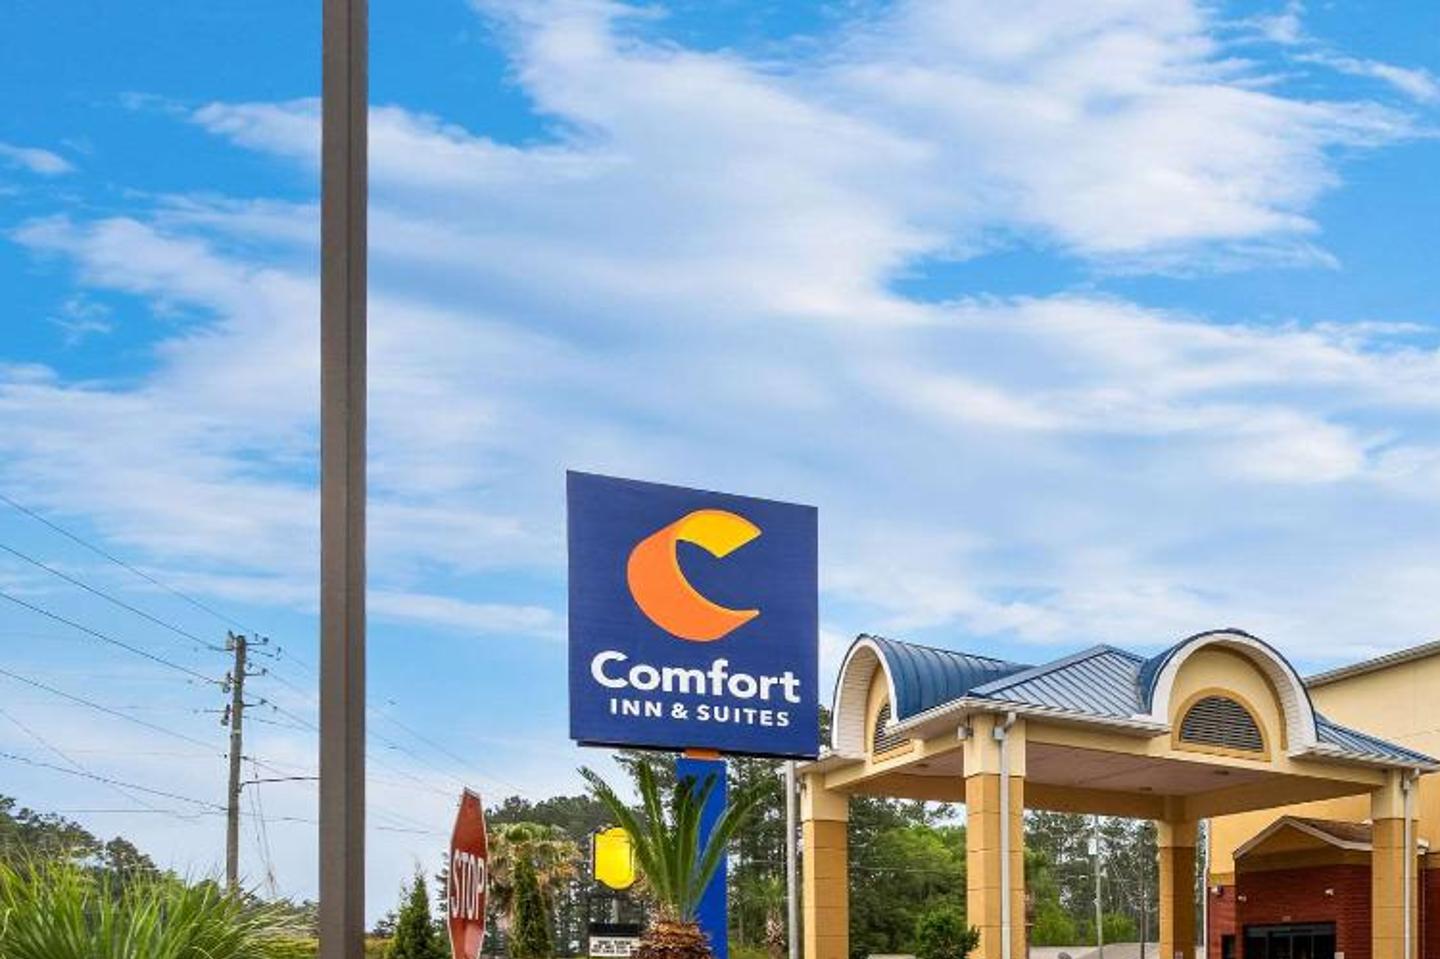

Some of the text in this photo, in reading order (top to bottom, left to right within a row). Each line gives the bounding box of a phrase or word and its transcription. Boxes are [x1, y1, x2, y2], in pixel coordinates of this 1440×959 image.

[590, 650, 801, 703] Comfort
[610, 698, 790, 727] INN & SUITES
[451, 848, 485, 920] STOP
